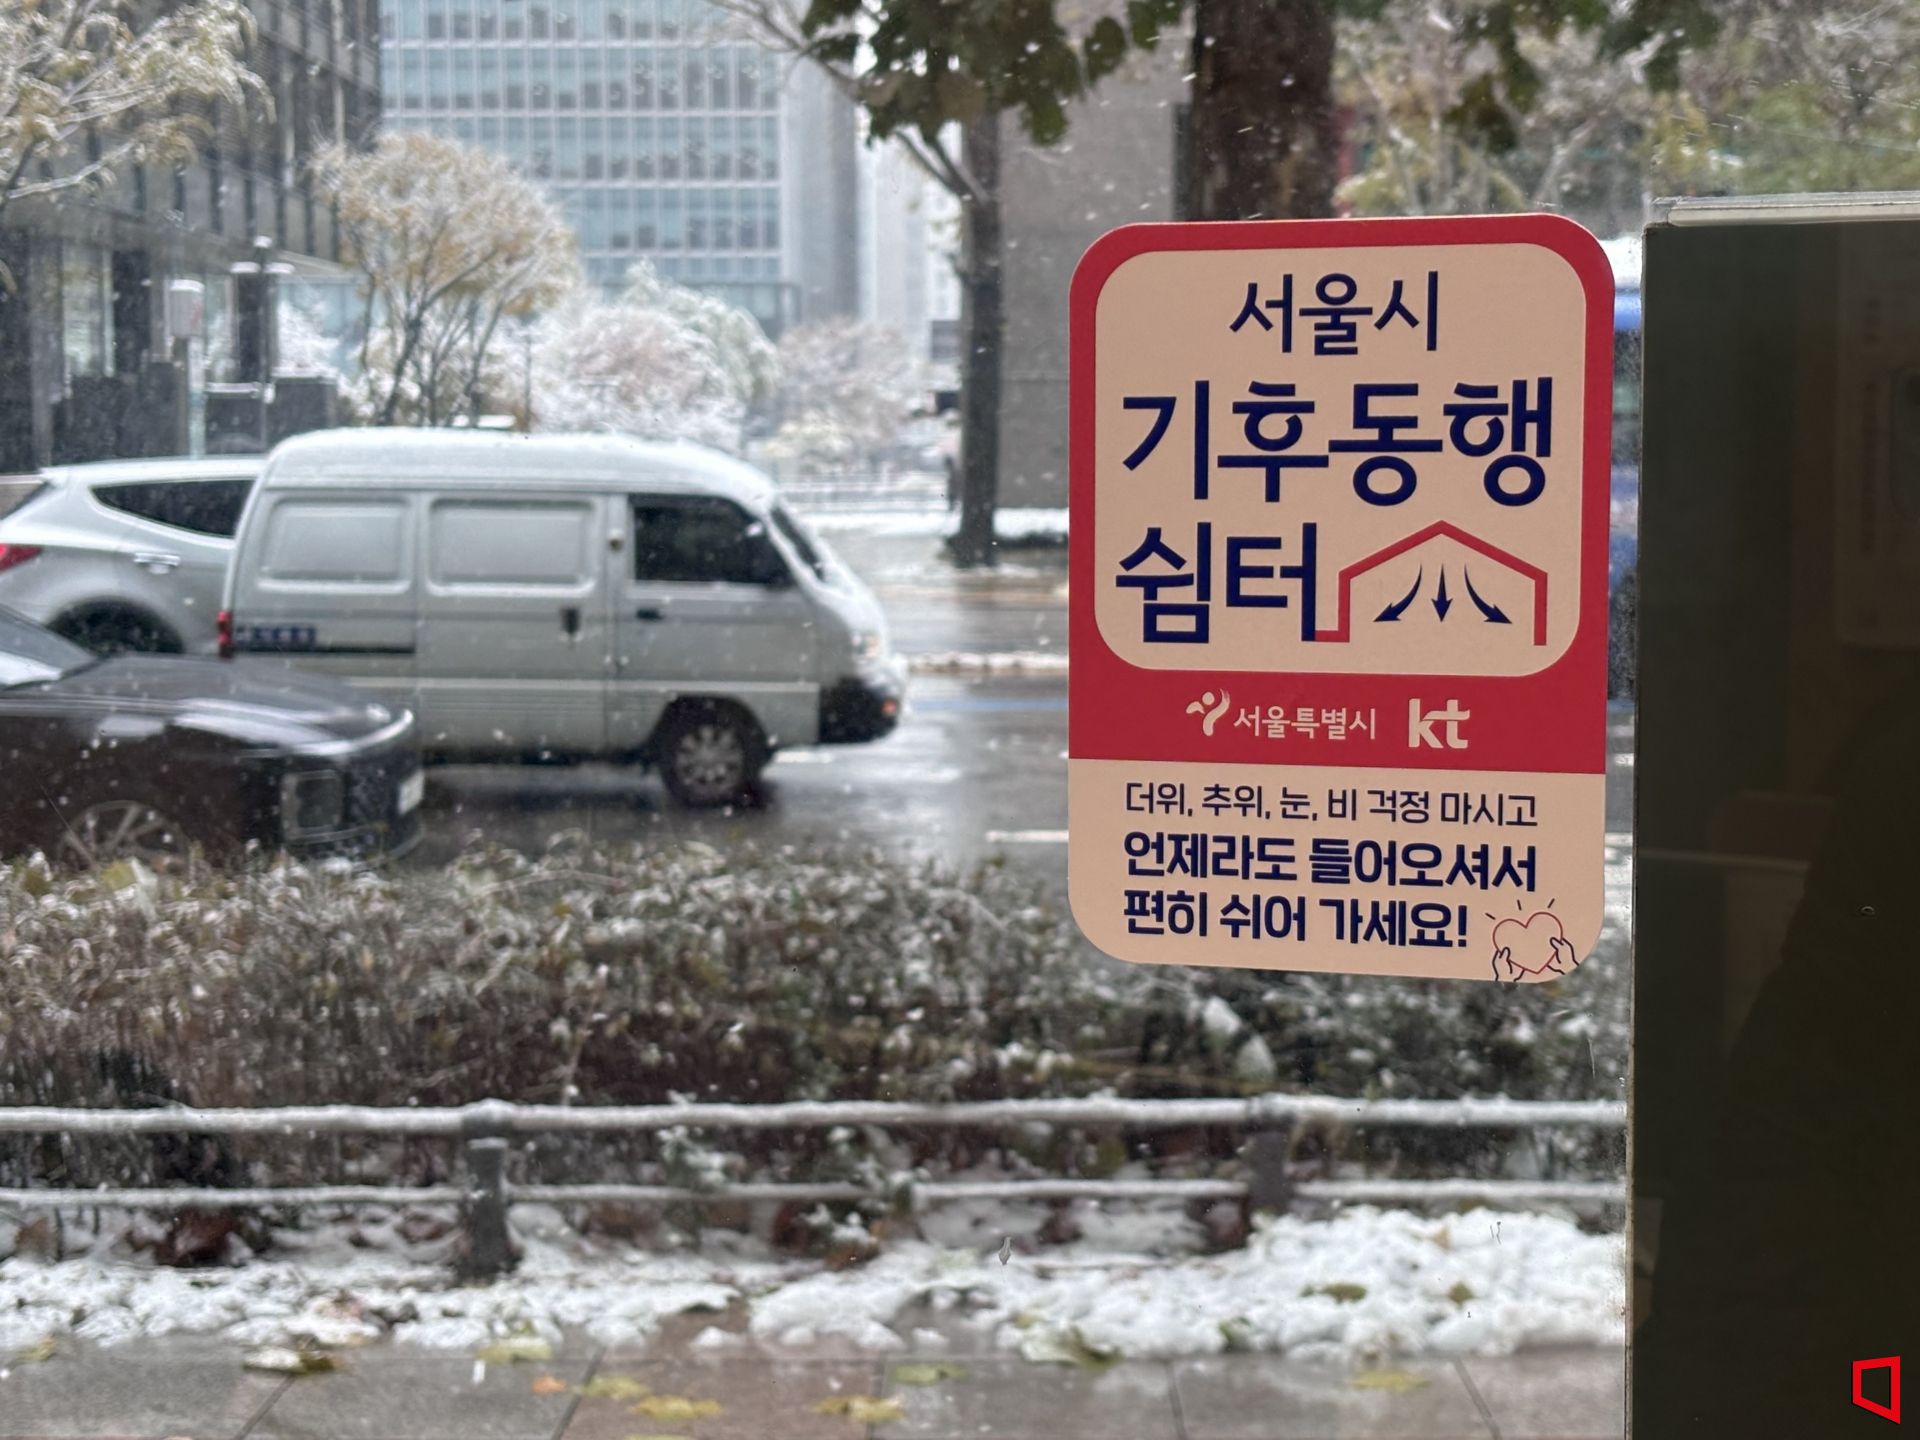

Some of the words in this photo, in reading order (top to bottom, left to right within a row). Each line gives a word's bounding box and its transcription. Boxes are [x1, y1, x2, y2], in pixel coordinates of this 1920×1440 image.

[1229, 271, 1438, 354] 서울시
[1122, 376, 1553, 506] 기후동행
[1115, 521, 1317, 643] 쉼터
[1233, 705, 1375, 740] 서울특별시
[1408, 698, 1470, 749] kt
[1126, 782, 1193, 817] 더위,
[1202, 784, 1270, 819] 추위,
[1280, 787, 1317, 821] 눈,
[1328, 789, 1357, 821] 비
[1367, 790, 1429, 823] 걱정
[1440, 792, 1538, 826] 마시고
[1124, 831, 1297, 880] 언제라도
[1309, 838, 1536, 892] 들어오셔서
[1124, 889, 1208, 937] 편히
[1220, 894, 1306, 941] 쉬어
[1319, 898, 1467, 948] 가세요!
